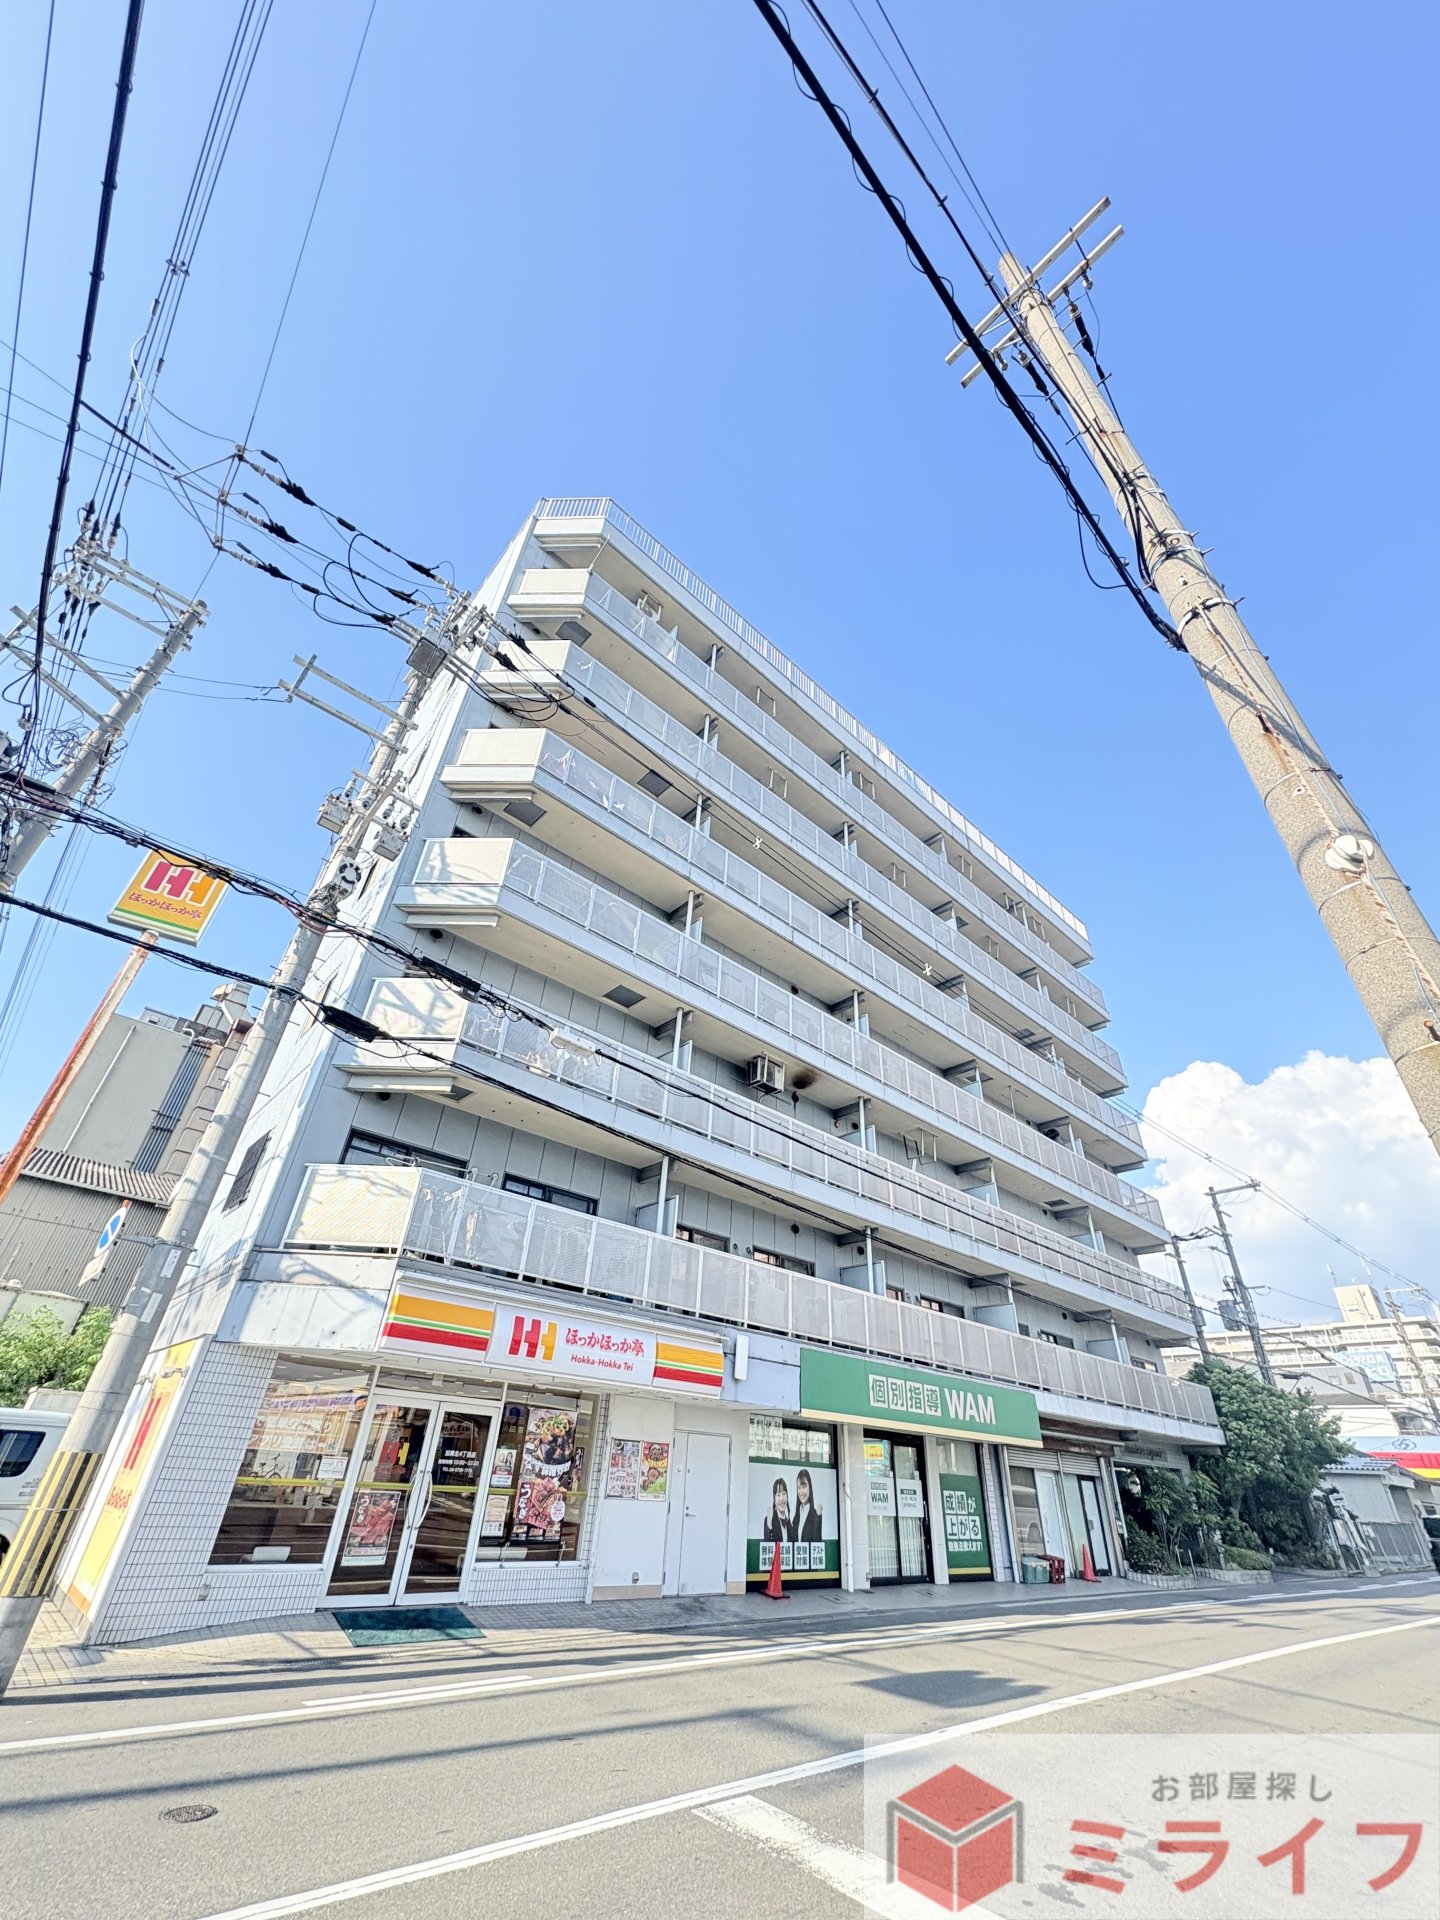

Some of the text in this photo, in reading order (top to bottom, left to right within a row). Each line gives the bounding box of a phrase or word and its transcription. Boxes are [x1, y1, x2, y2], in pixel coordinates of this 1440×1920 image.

[127, 891, 204, 920] ほっかほっか亭
[565, 1326, 646, 1358] ほっかほっか亭
[570, 1353, 635, 1372] Hokka-Hokka Tei
[869, 1375, 997, 1425] 個別指導 WAM
[517, 1483, 533, 1520] うなぎ
[870, 1492, 889, 1504] WAM
[944, 1492, 977, 1514] 成績が
[947, 1517, 980, 1537] 上がる
[761, 1545, 774, 1556] 無料
[795, 1545, 808, 1556] 受験
[812, 1545, 824, 1556] テスト
[795, 1556, 808, 1567] 対策
[812, 1556, 824, 1567] 対策
